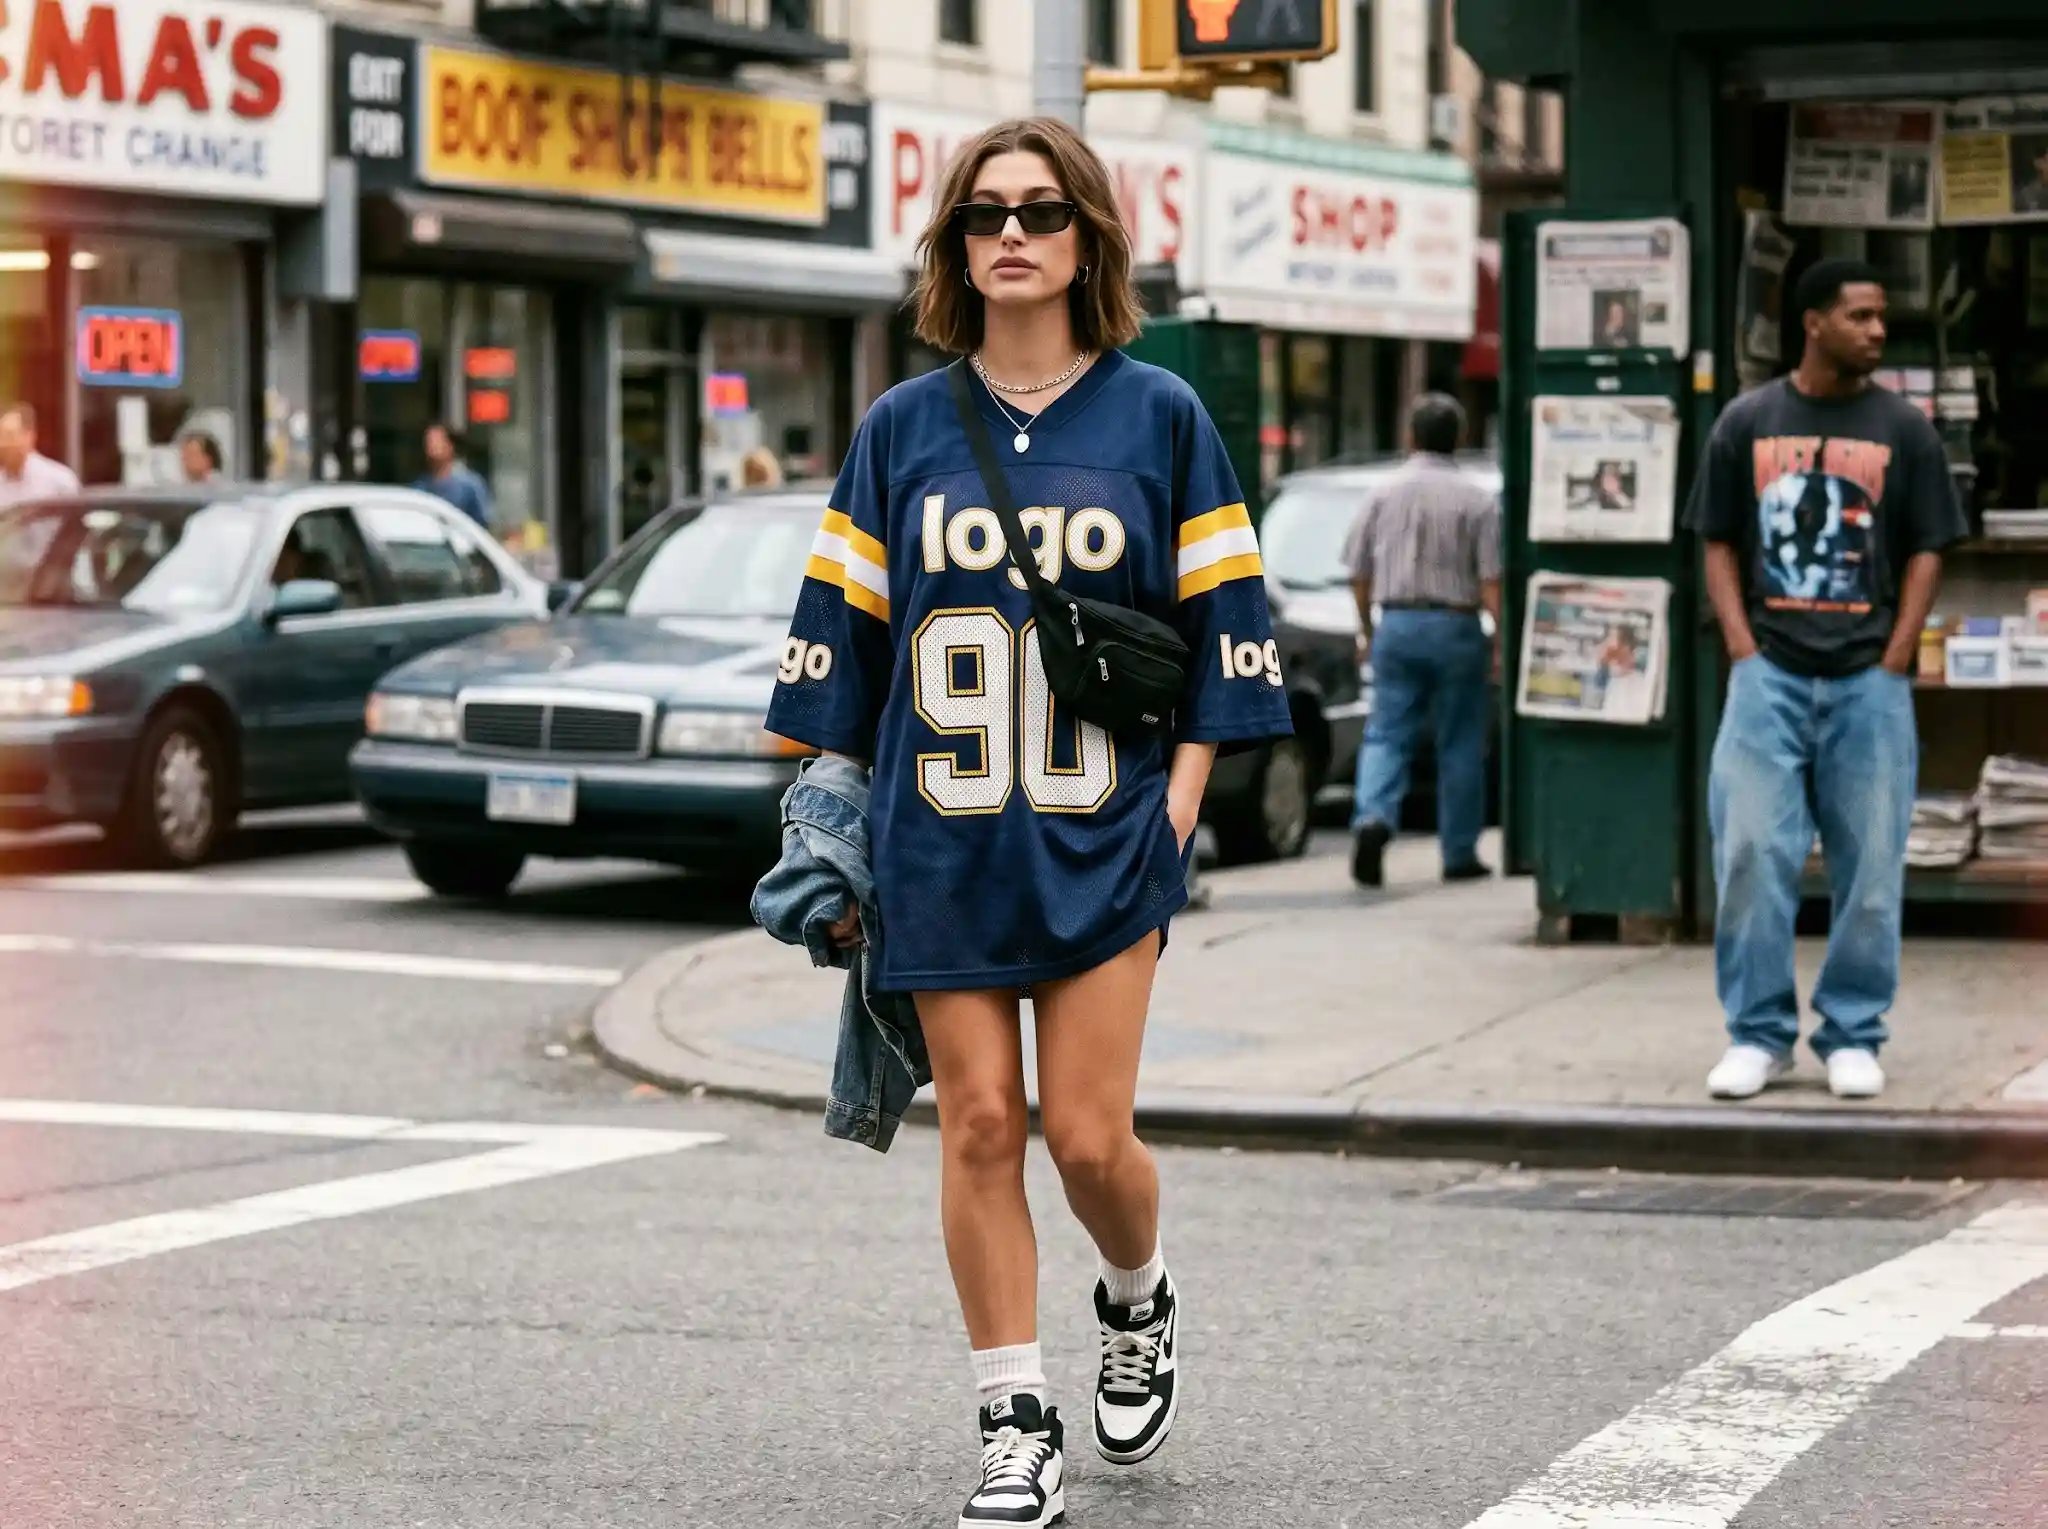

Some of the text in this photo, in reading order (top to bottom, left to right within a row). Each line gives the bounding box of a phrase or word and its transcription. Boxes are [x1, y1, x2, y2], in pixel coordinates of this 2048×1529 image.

[0, 0, 283, 121] MA'S
[1290, 183, 1397, 252] SHOP
[86, 314, 177, 377] OPEN
[922, 494, 1126, 591] logo
[911, 607, 1119, 816] 90
